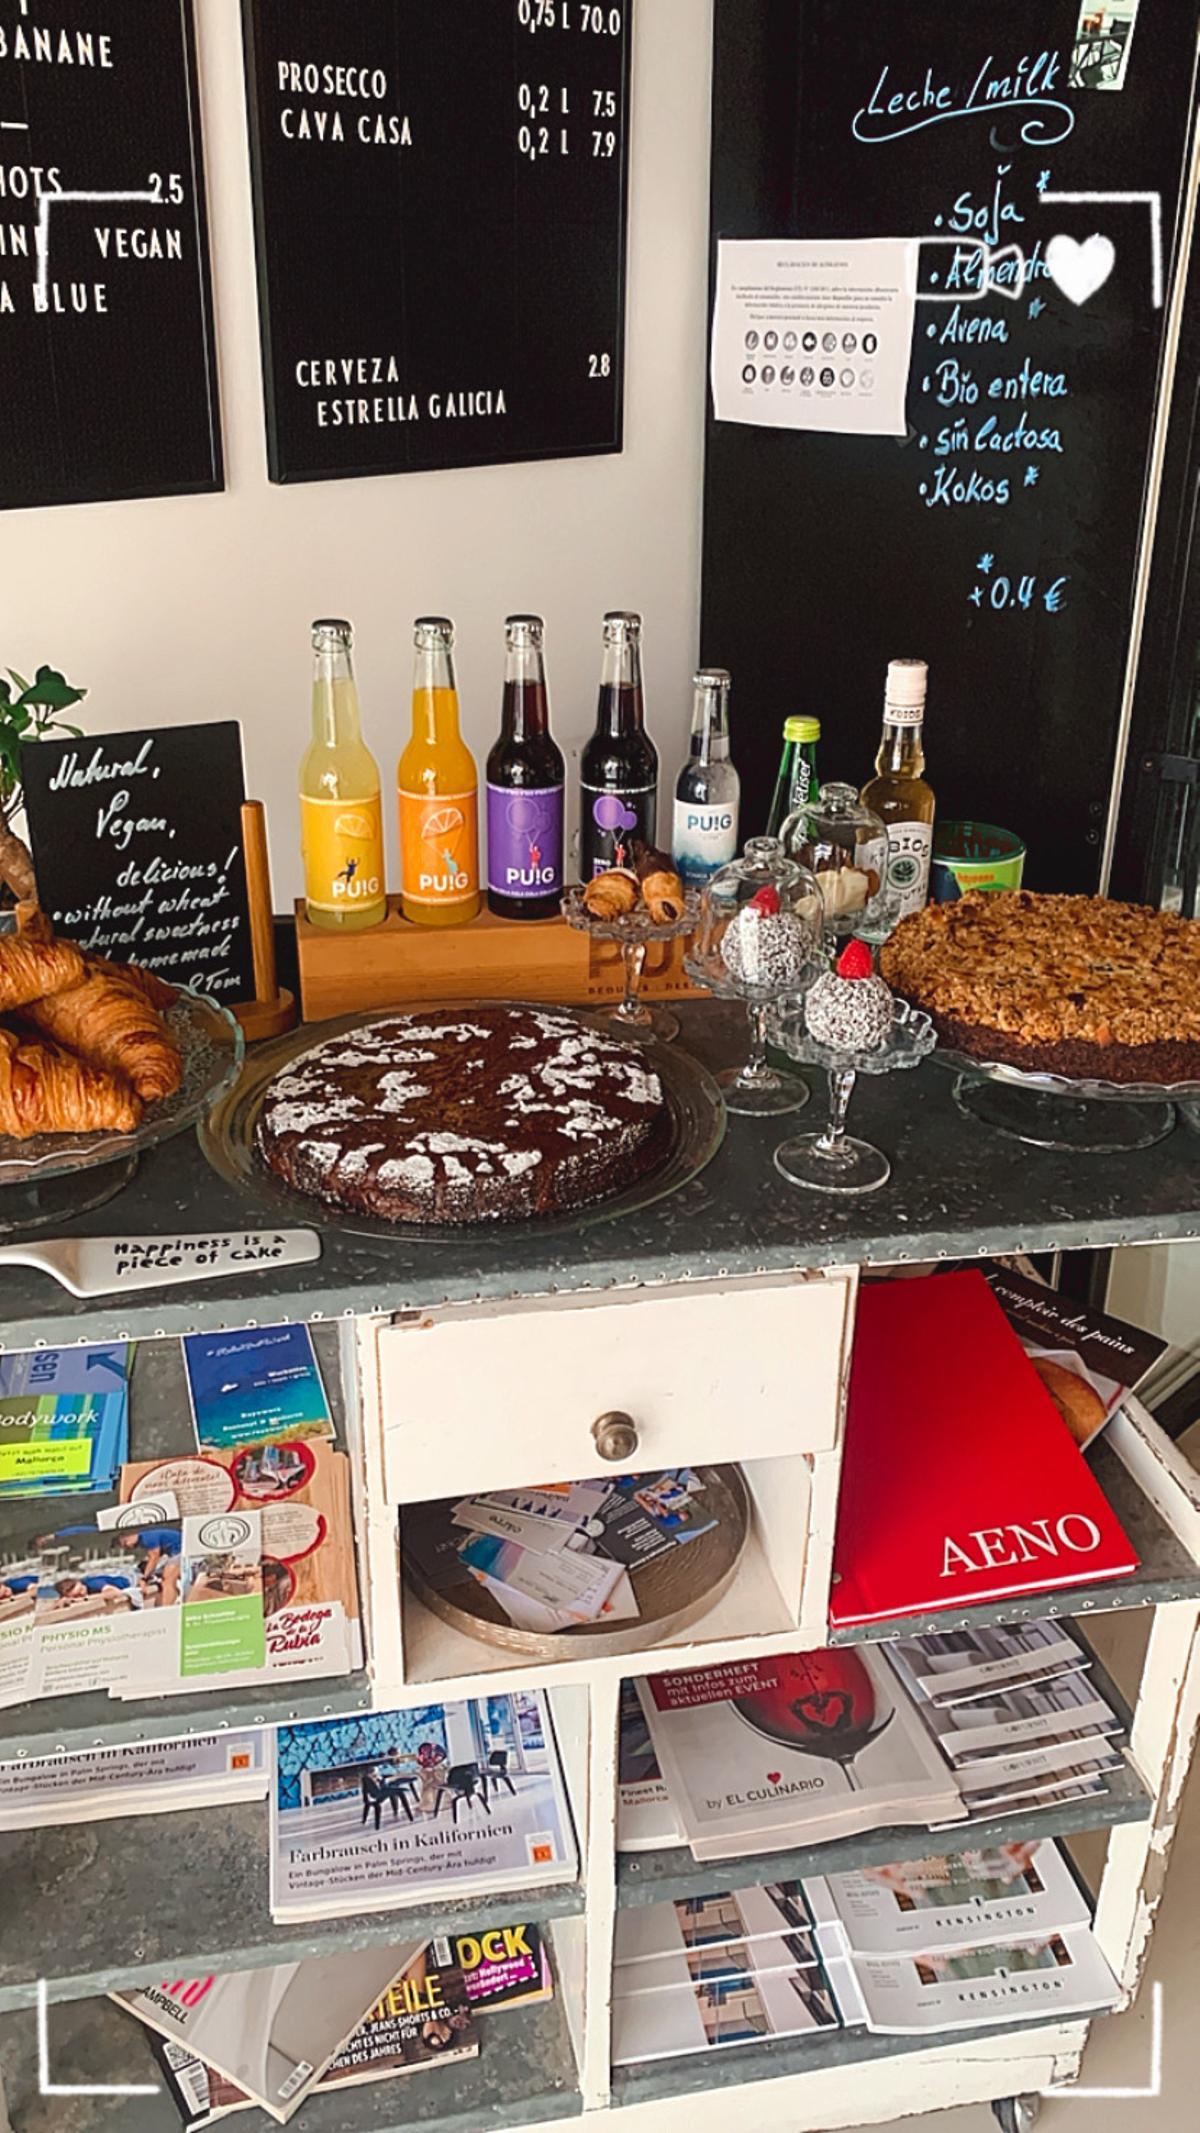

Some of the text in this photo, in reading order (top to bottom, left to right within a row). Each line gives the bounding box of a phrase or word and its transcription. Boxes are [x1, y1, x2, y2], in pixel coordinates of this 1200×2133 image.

[518, 0, 555, 33] 0,75
[580, 4, 621, 35] 70.0
[0, 25, 113, 67] BANANE
[278, 61, 386, 98] PROSECCO
[867, 66, 951, 114] Leche
[518, 83, 549, 119] 0,2
[592, 90, 616, 117] 7.5
[281, 108, 413, 146] CAVA CASA
[518, 126, 548, 161] 0,2
[592, 131, 616, 157] 7.9
[149, 173, 184, 204] 2.5
[949, 164, 1025, 245] Soja
[94, 227, 183, 260] VEGAN
[33, 282, 108, 313] BLUE
[939, 304, 1009, 345] Avena
[296, 356, 400, 387] CERVEZA
[588, 354, 611, 378] 2.8
[936, 357, 1067, 407] Bio entera
[318, 389, 507, 427] ESTRELLA GALICIA
[934, 411, 1064, 455] sin lactosa
[926, 464, 1009, 507] Kokos
[1044, 576, 1070, 613] €
[64, 886, 230, 925] without wheat
[144, 912, 240, 942] sweetness
[114, 1235, 287, 1257] Happiness is a
[117, 1247, 282, 1275] piece of cake
[1060, 1314, 1089, 1333] des
[1080, 1330, 1136, 1355] pains
[939, 1513, 1101, 1578] AENO
[42, 1628, 90, 1643] PHYSIO
[279, 1609, 333, 1635] Bodega
[662, 1663, 760, 1688] SONDERHEFT
[667, 1674, 758, 1697] mit Infos zum
[670, 1679, 779, 1706] aktuellen EVENT
[706, 1777, 825, 1810] by EL CULINARIO
[289, 1823, 513, 1865] Farbrausch in Kalifornien
[935, 1905, 1036, 1928] KENSINGTON
[135, 1986, 191, 2025] AMPBELL
[957, 1980, 1063, 2002] KENSINGTON
